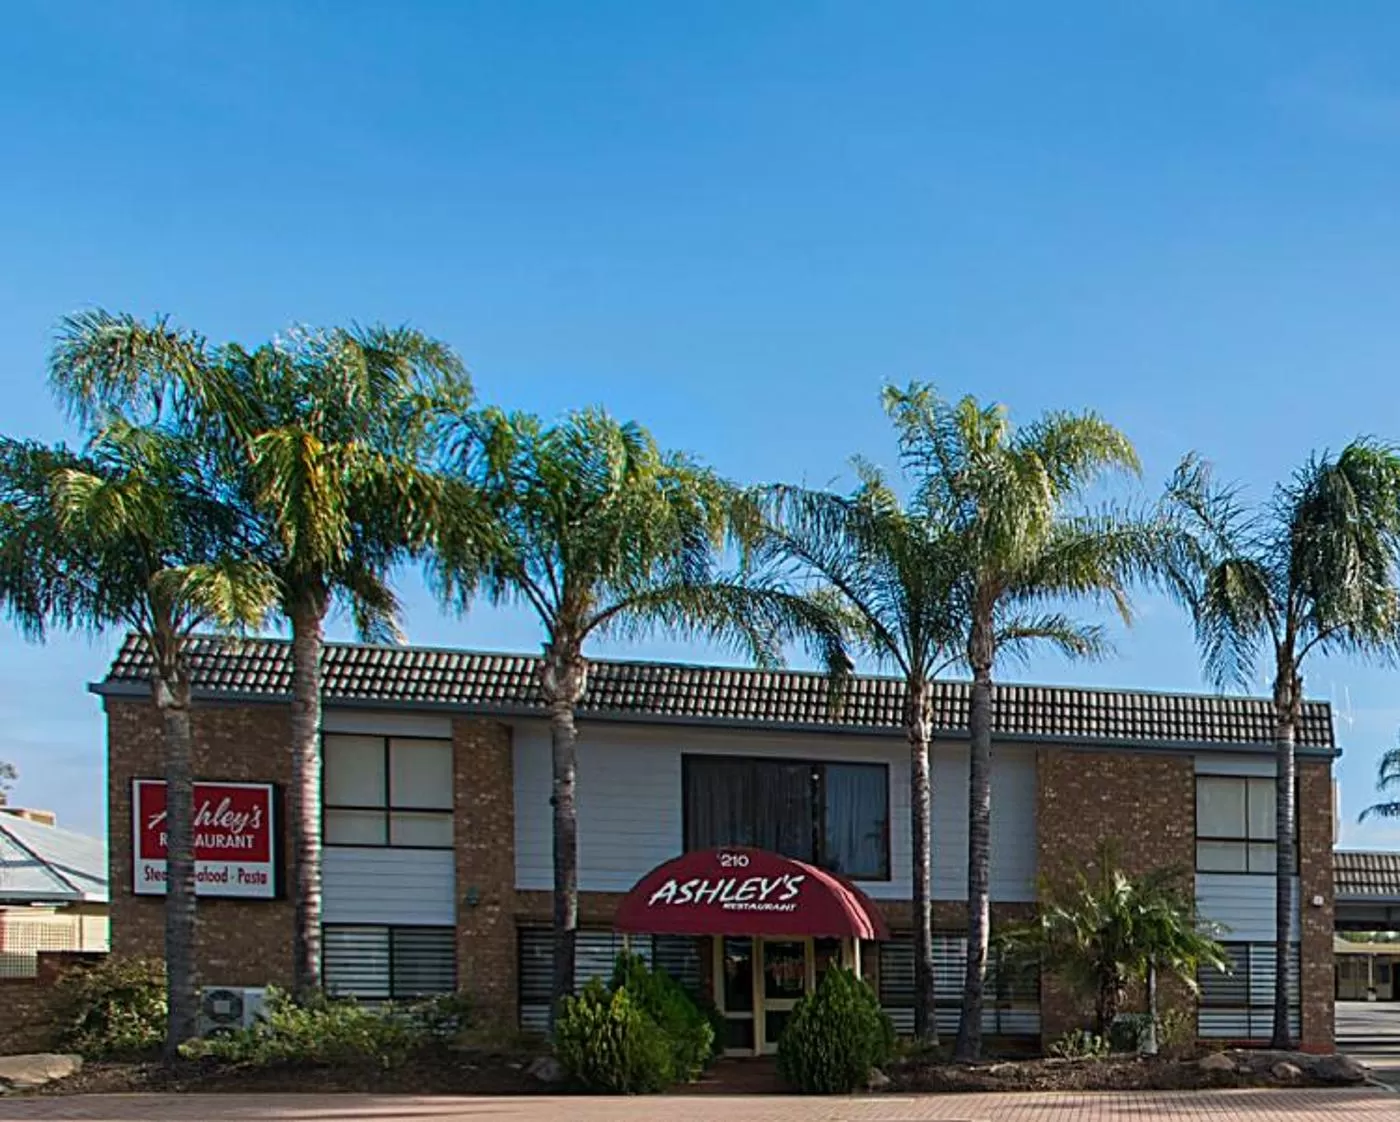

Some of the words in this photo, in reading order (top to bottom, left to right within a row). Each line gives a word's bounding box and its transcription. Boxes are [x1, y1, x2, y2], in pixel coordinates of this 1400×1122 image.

[148, 797, 263, 834] hley's
[159, 833, 255, 848] RAURANT
[720, 854, 750, 868] 210
[144, 865, 168, 881] Stea
[194, 866, 229, 883] afood
[237, 867, 267, 884] Pasta
[648, 874, 806, 906] ASHLEY'S
[723, 902, 797, 912] RESTAURANT
